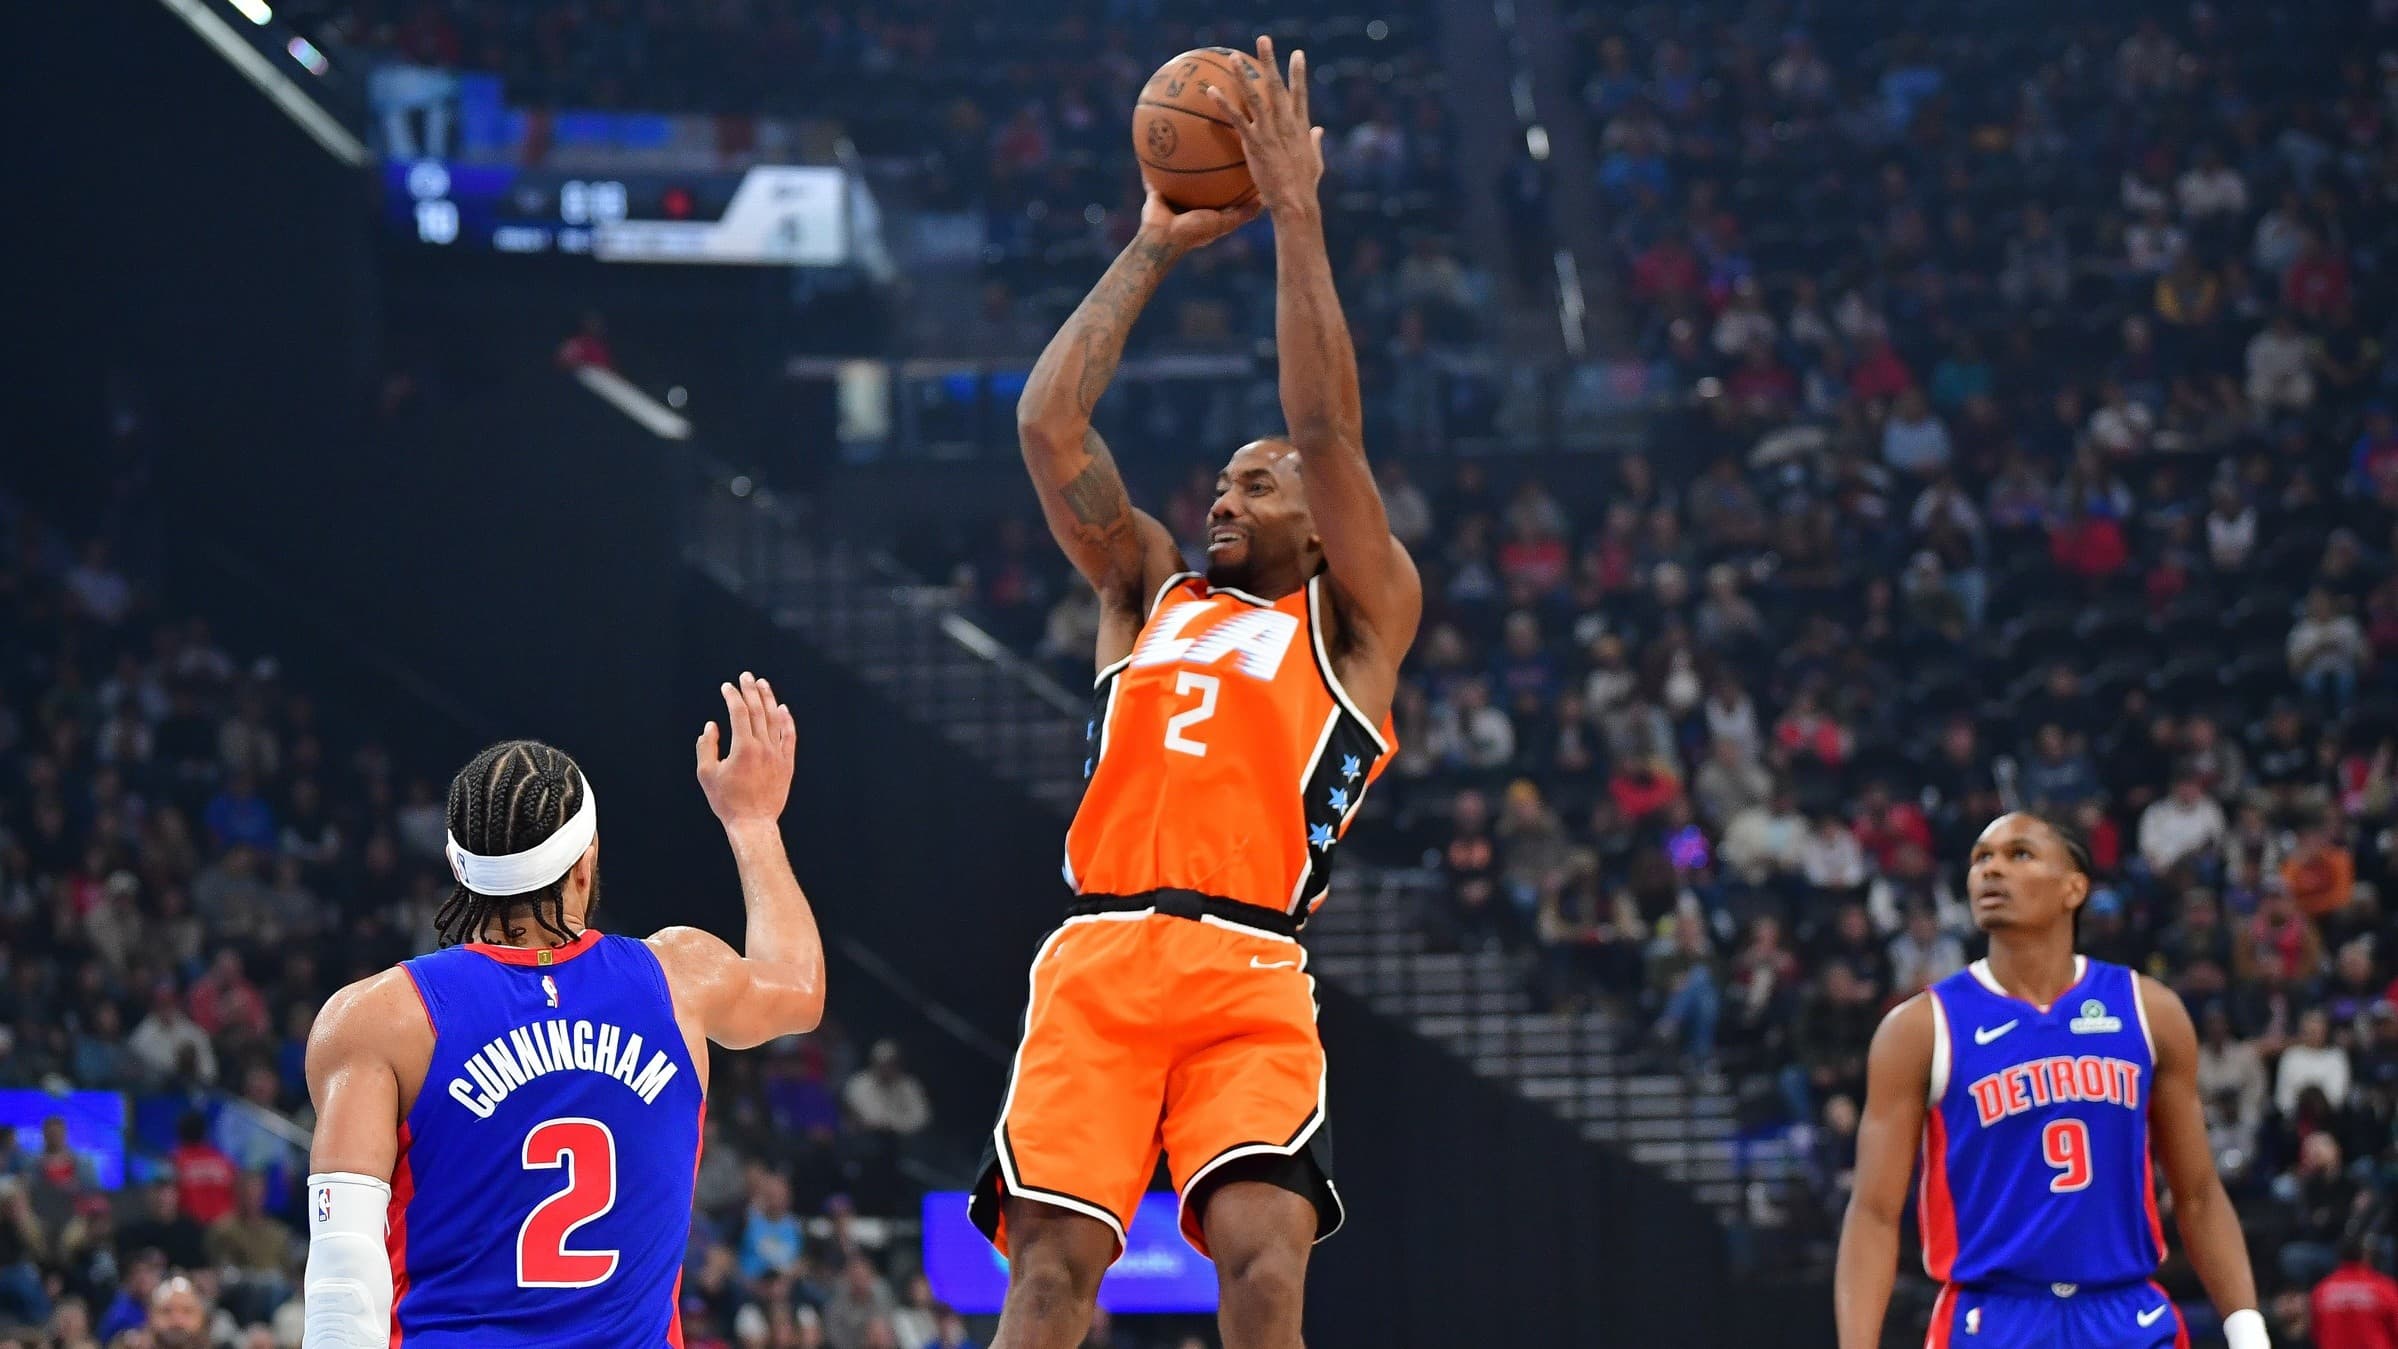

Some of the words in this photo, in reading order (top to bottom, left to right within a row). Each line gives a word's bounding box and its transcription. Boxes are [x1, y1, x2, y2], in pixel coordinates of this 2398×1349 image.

[1128, 600, 1299, 681] LA
[1164, 671, 1221, 757] 2
[448, 1019, 678, 1120] CUNNINGHAM
[1968, 1055, 2142, 1128] DETROIT
[2043, 1119, 2093, 1192] 9
[517, 1117, 620, 1288] 2
